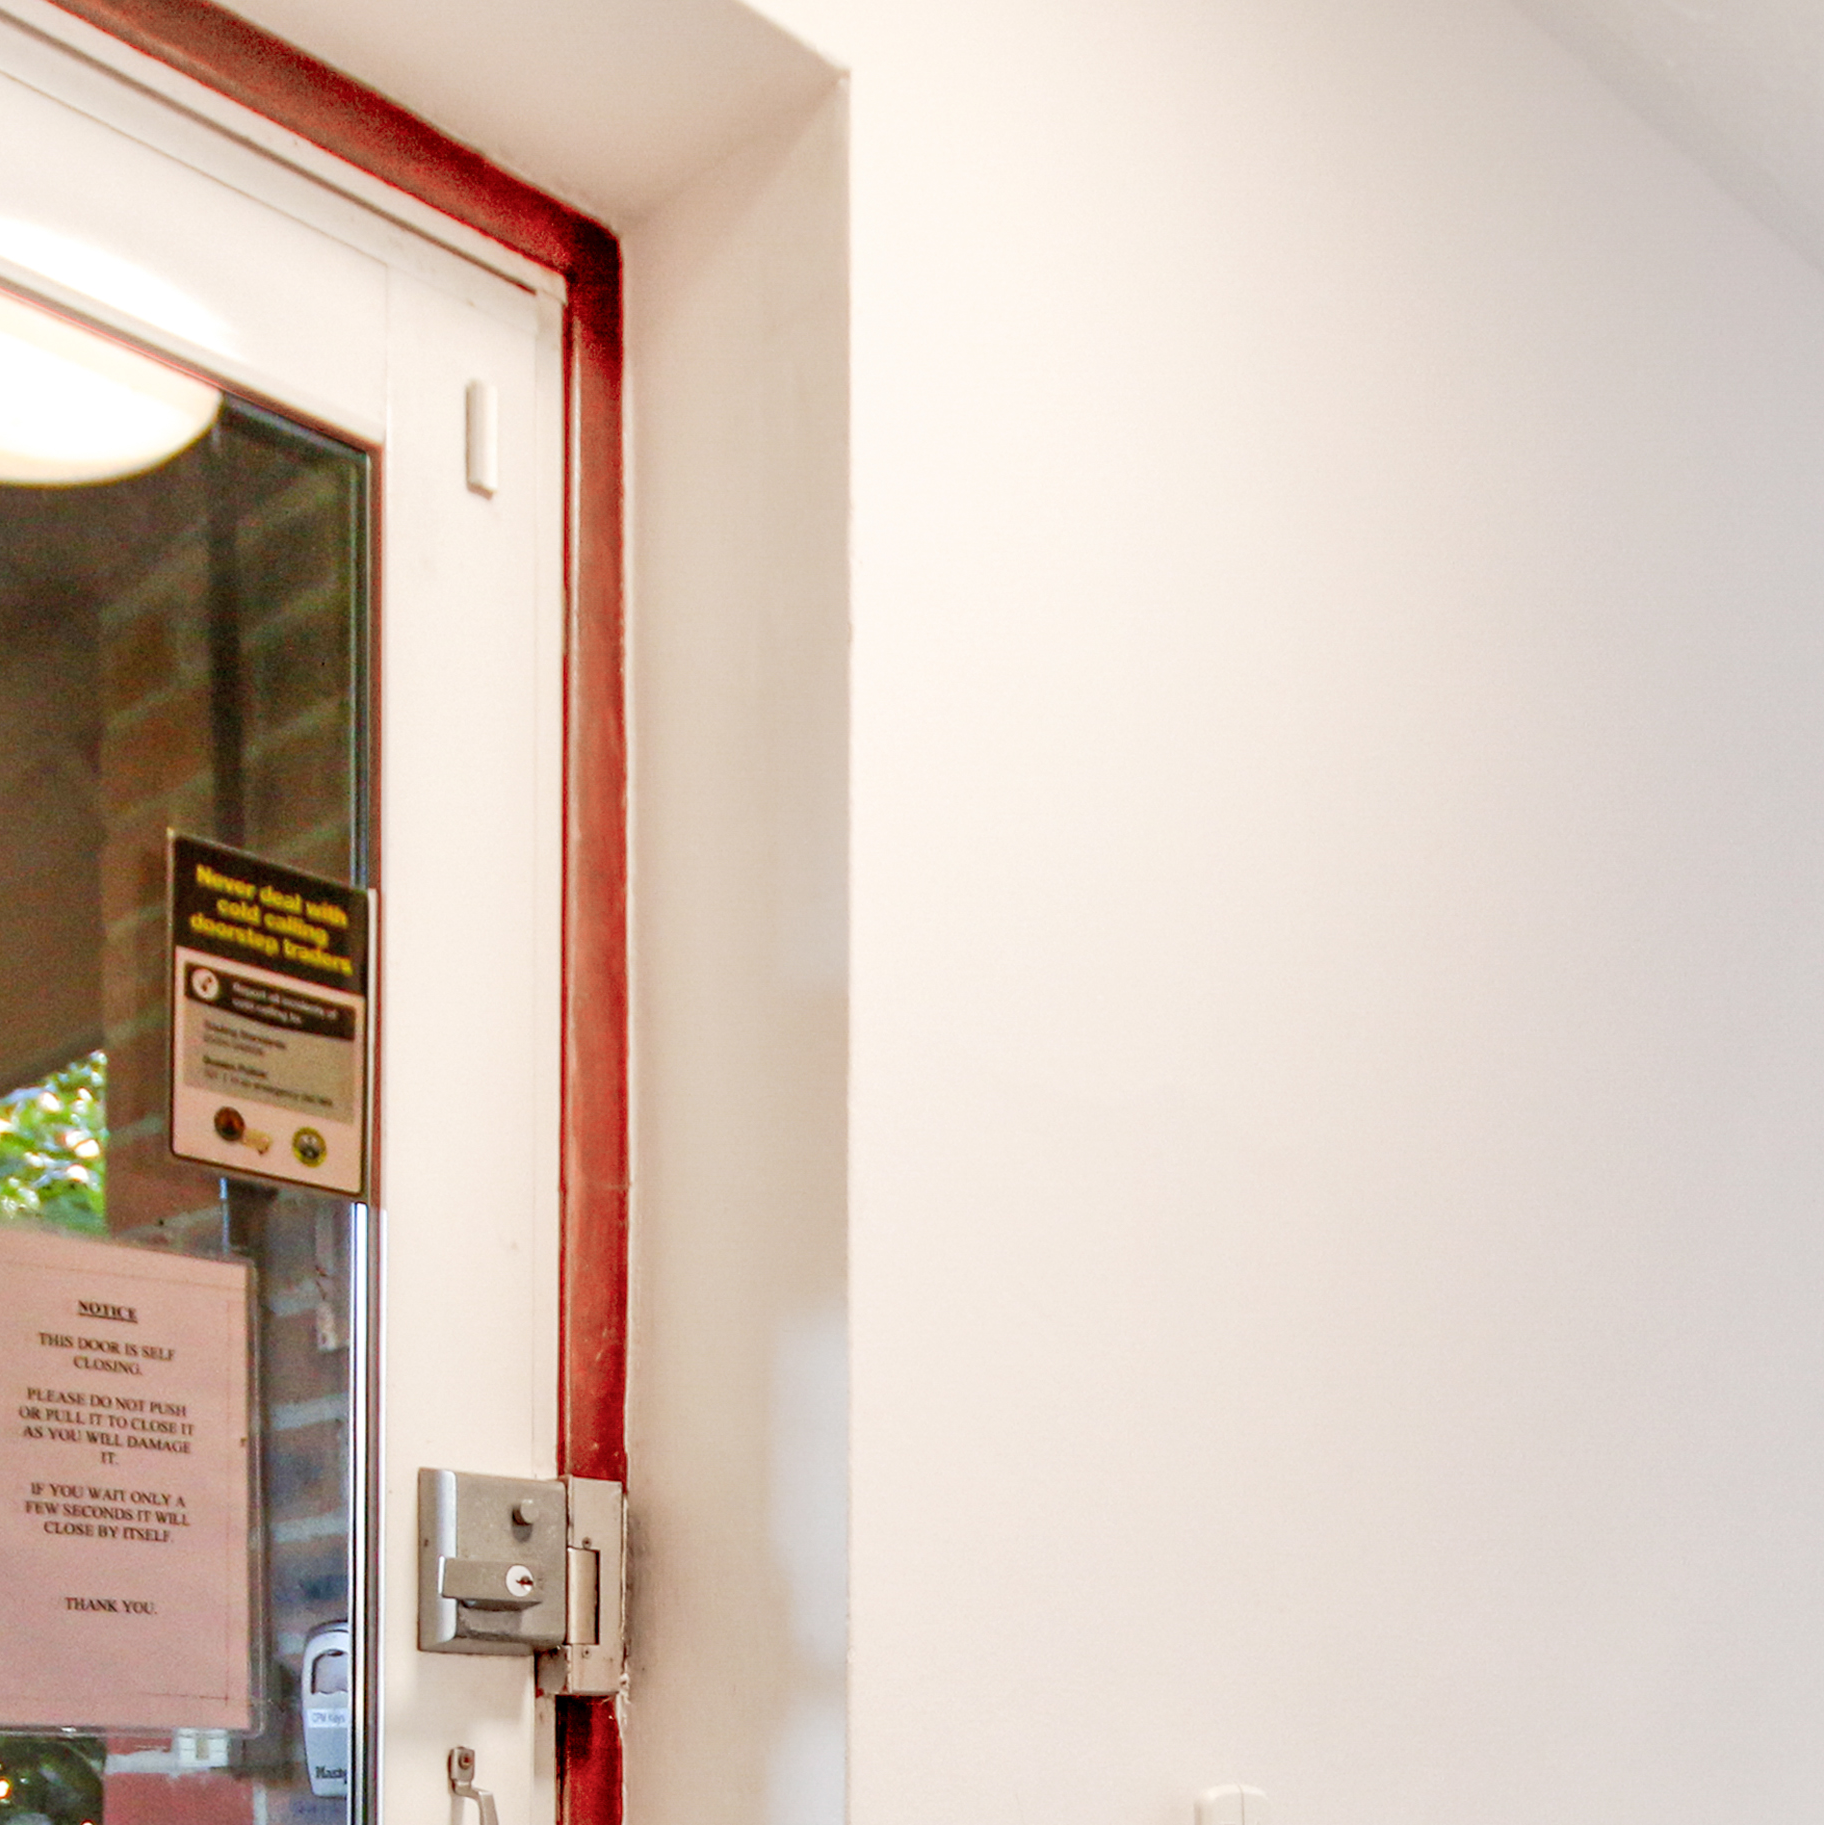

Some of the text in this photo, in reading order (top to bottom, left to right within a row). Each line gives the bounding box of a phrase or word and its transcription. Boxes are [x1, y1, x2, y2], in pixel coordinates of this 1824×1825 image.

[196, 864, 348, 929] Never deal with
[217, 899, 329, 948] cold calling
[189, 912, 353, 976] doorstep traders
[78, 1300, 138, 1322] NOTICE
[38, 1332, 175, 1361] THIS DOOR IS SELF
[73, 1355, 143, 1376] CLOSING.
[27, 1387, 187, 1417] PLEASE DO NOT PUSH
[19, 1406, 195, 1436] OR PULL IT TO CLOSE IT
[23, 1425, 192, 1454] AS YOU WILL DAMAGE
[100, 1451, 119, 1466] IT.
[30, 1482, 187, 1508] IF YOU WAIT ONLY A
[25, 1500, 191, 1527] FEW SECONDS IT WILL
[43, 1521, 174, 1544] CLOSE BY ITSELF.
[65, 1596, 158, 1615] THANK YOU.
